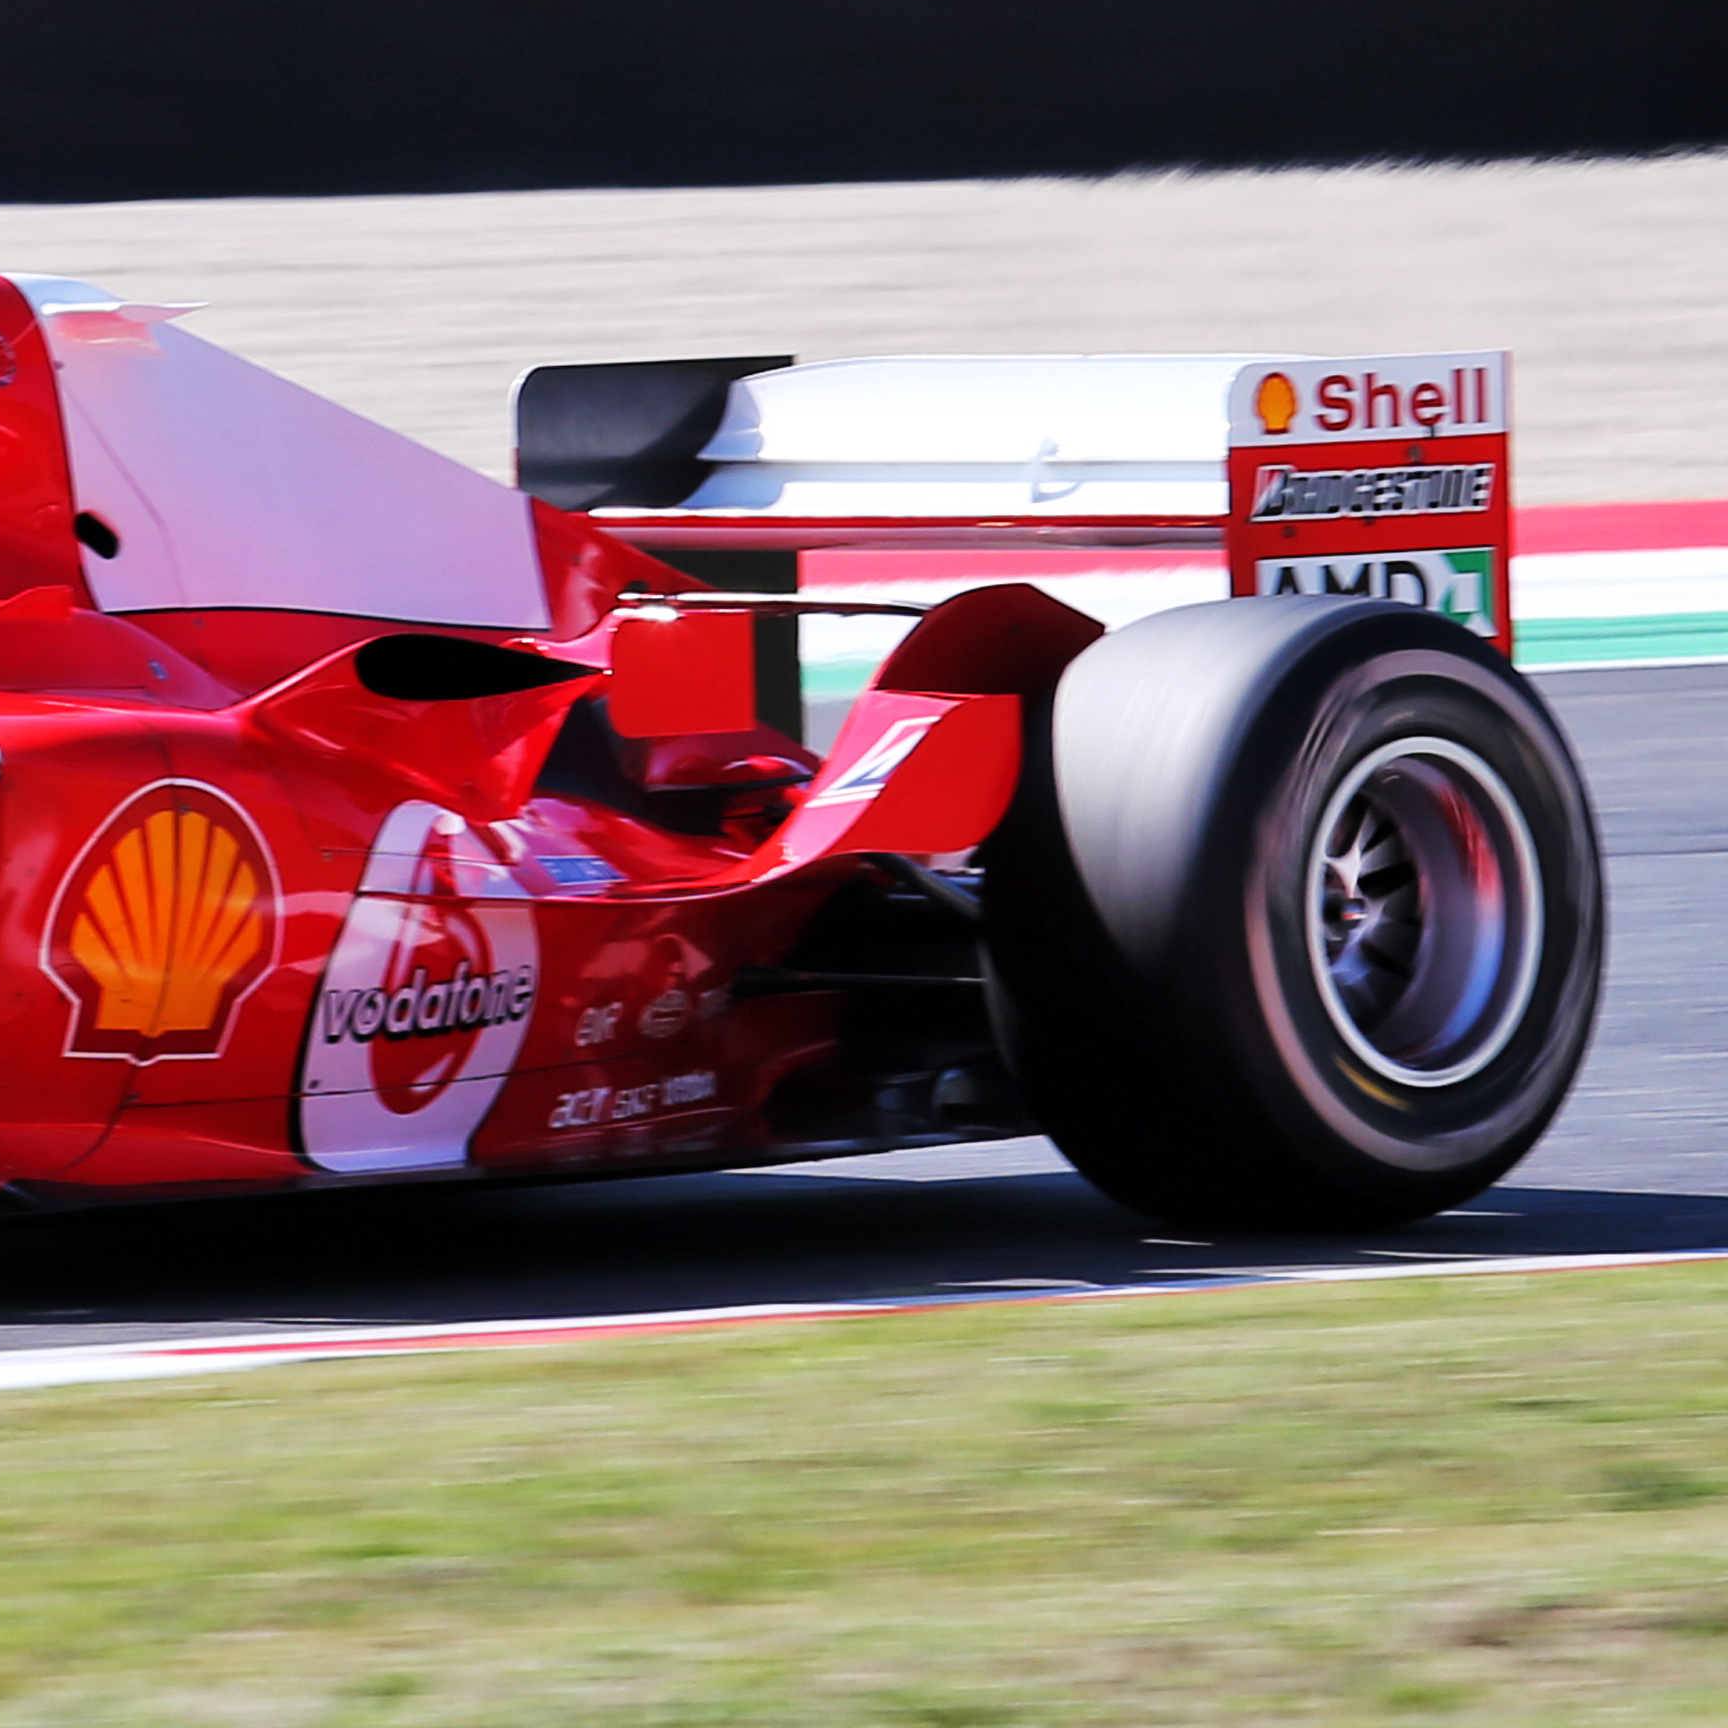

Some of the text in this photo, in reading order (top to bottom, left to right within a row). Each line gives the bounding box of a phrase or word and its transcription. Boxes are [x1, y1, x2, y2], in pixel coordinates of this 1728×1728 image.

[1315, 367, 1485, 432] Shell
[1275, 559, 1428, 606] AMD
[324, 959, 535, 1042] vodafone
